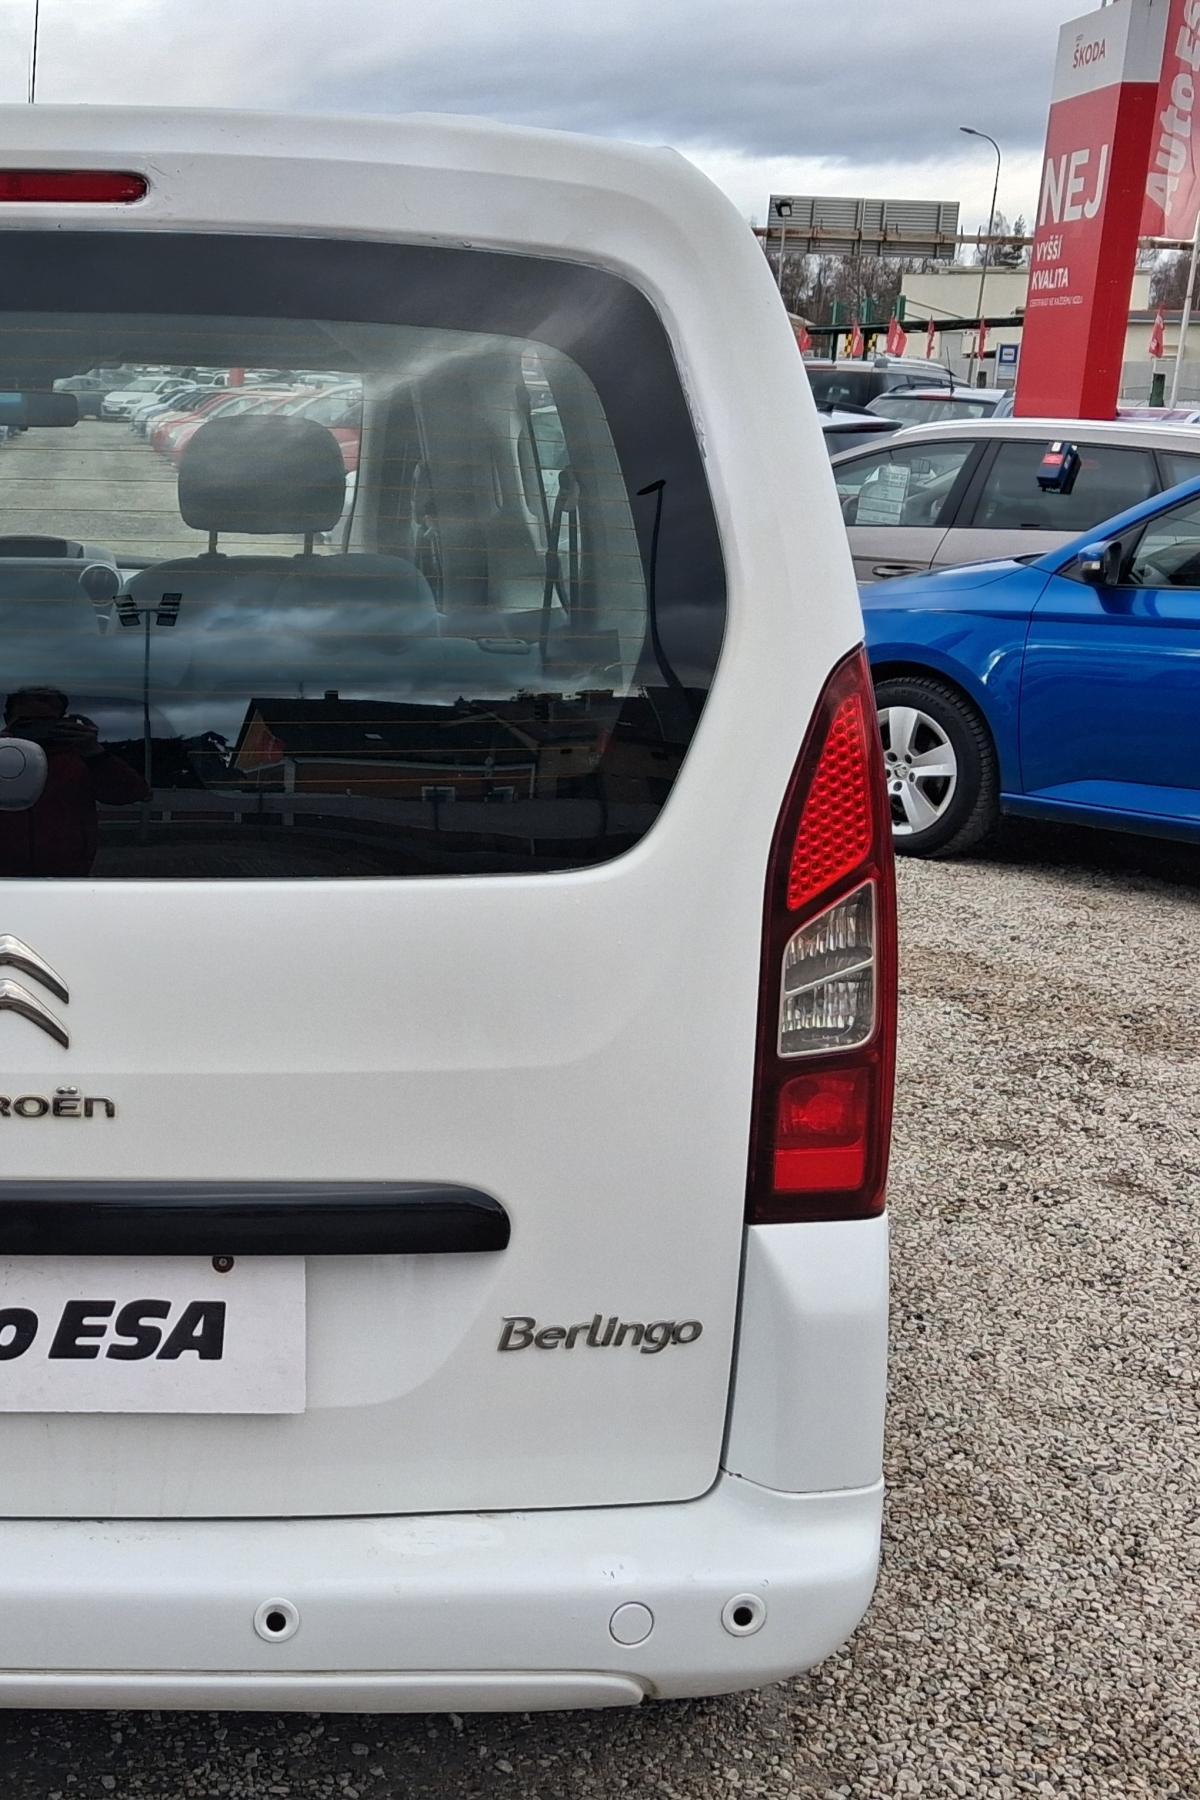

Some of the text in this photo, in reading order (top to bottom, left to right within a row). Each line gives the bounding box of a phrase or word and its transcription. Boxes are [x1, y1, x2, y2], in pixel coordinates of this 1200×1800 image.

[1073, 38, 1106, 69] ŠKODA
[1145, 73, 1194, 216] Auto
[1039, 143, 1109, 227] NEJ
[1037, 234, 1063, 262] VYŠŠÍ
[1031, 267, 1069, 290] KVALITA
[48, 1299, 227, 1361] ESA
[497, 1313, 704, 1354] Berlingo
